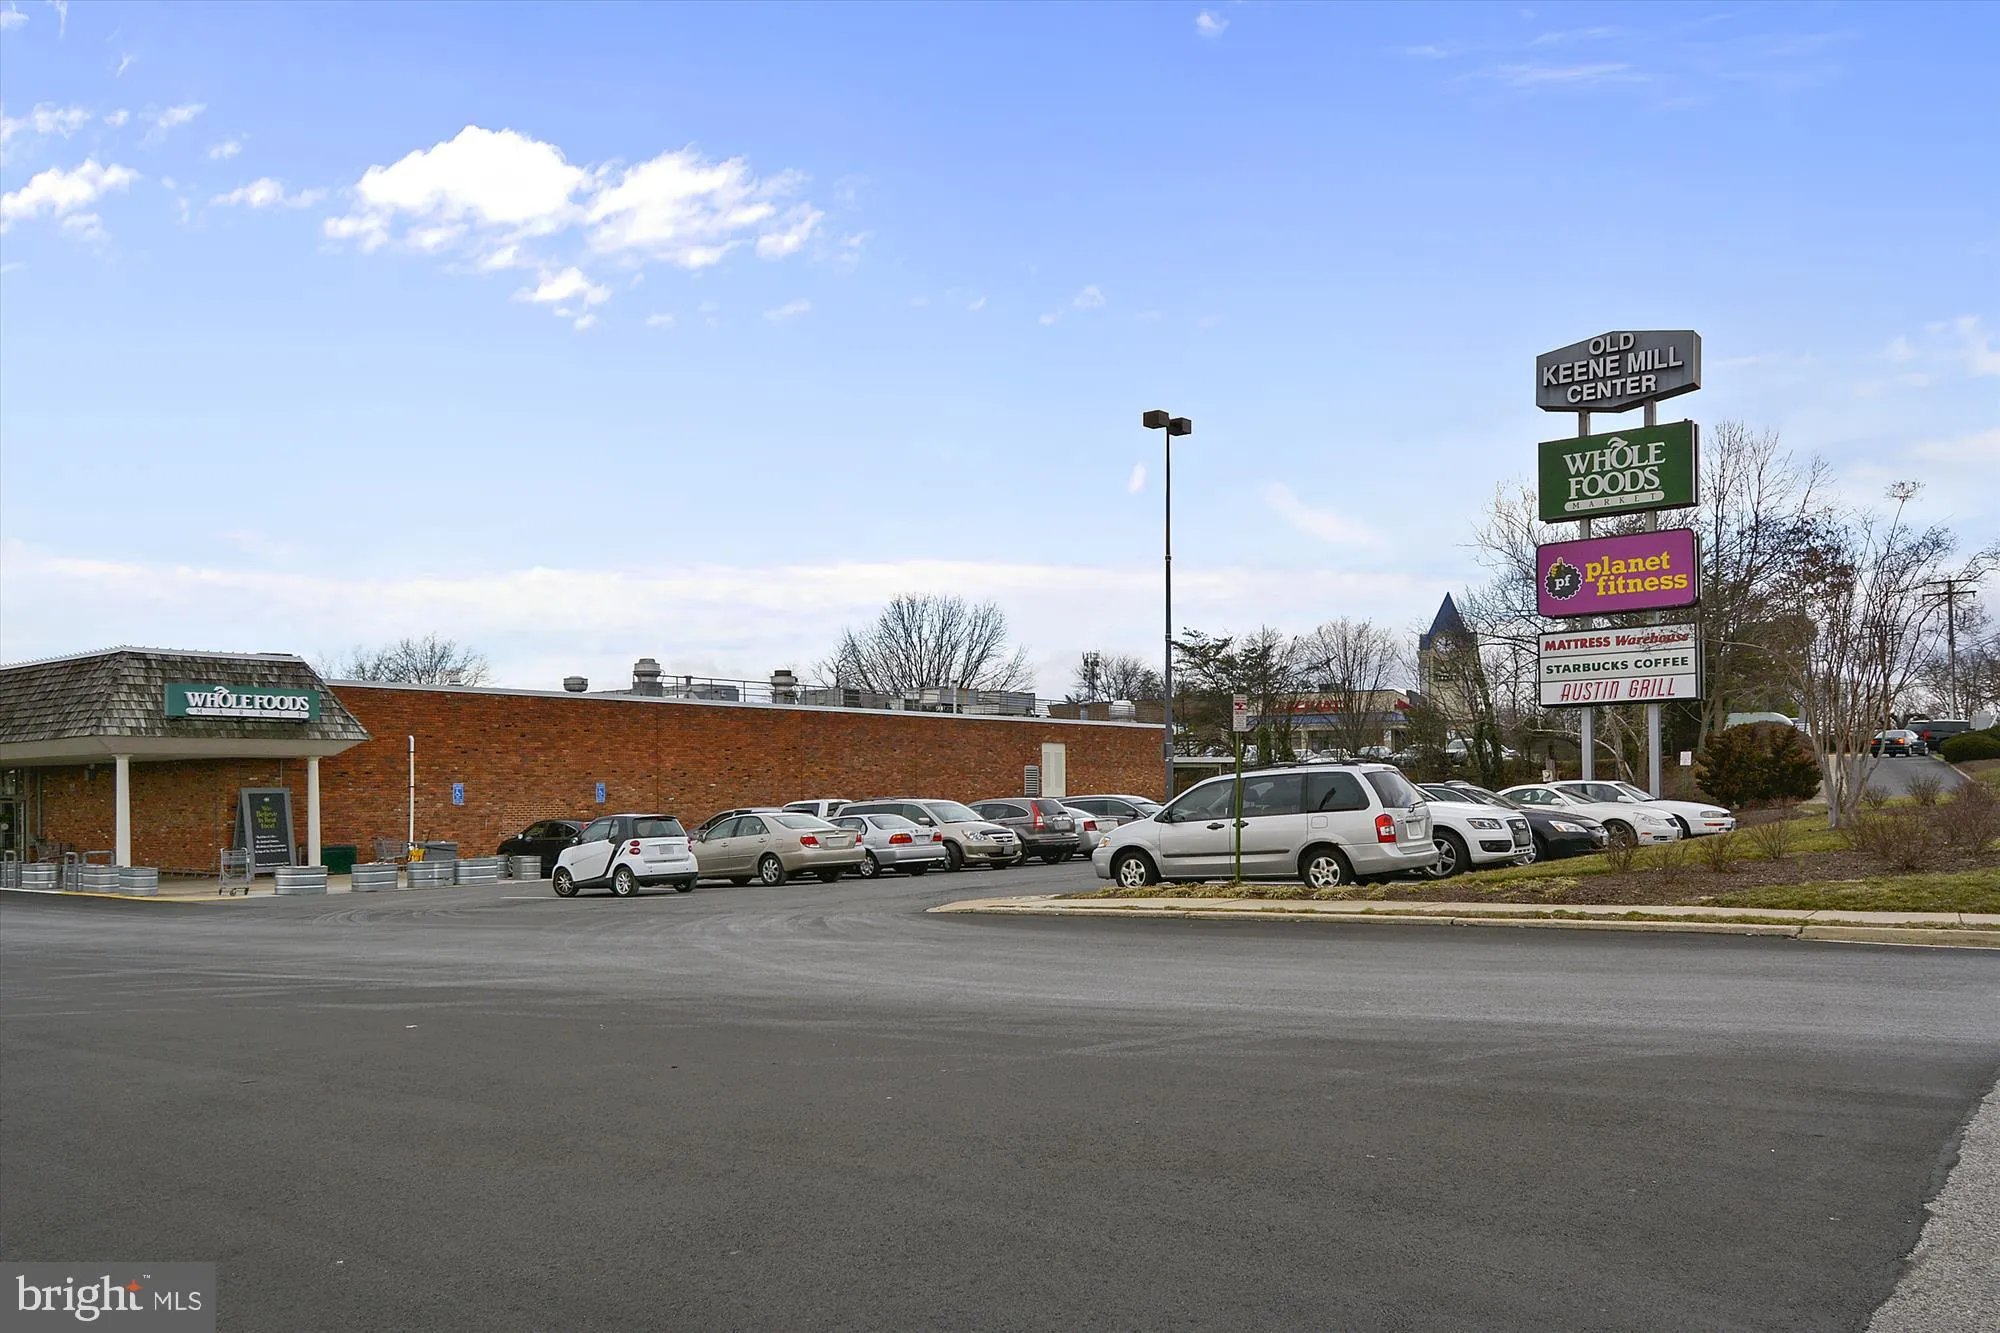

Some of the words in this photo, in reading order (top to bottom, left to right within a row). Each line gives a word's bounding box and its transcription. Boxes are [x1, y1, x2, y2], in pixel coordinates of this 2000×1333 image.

[1589, 332, 1635, 355] OLD
[1542, 356, 1620, 386] KEENE
[1627, 346, 1683, 374] MILL
[1566, 374, 1657, 403] CENTER
[1563, 438, 1666, 475] WHOLE
[1568, 466, 1661, 499] FOODS
[1572, 492, 1657, 509] MARKET
[1585, 551, 1670, 582] planet
[1554, 575, 1572, 591] pf
[1596, 573, 1688, 596] fitness
[1544, 636, 1611, 651] MATTRESS
[1615, 632, 1689, 648] Warehouse
[1546, 660, 1629, 674] STARBUCKS
[1634, 656, 1689, 669] COFFEE
[184, 687, 253, 708] WHOLE
[253, 695, 310, 711] FOODS
[1560, 680, 1620, 702] AUSTIN
[1628, 677, 1676, 698] GRILL
